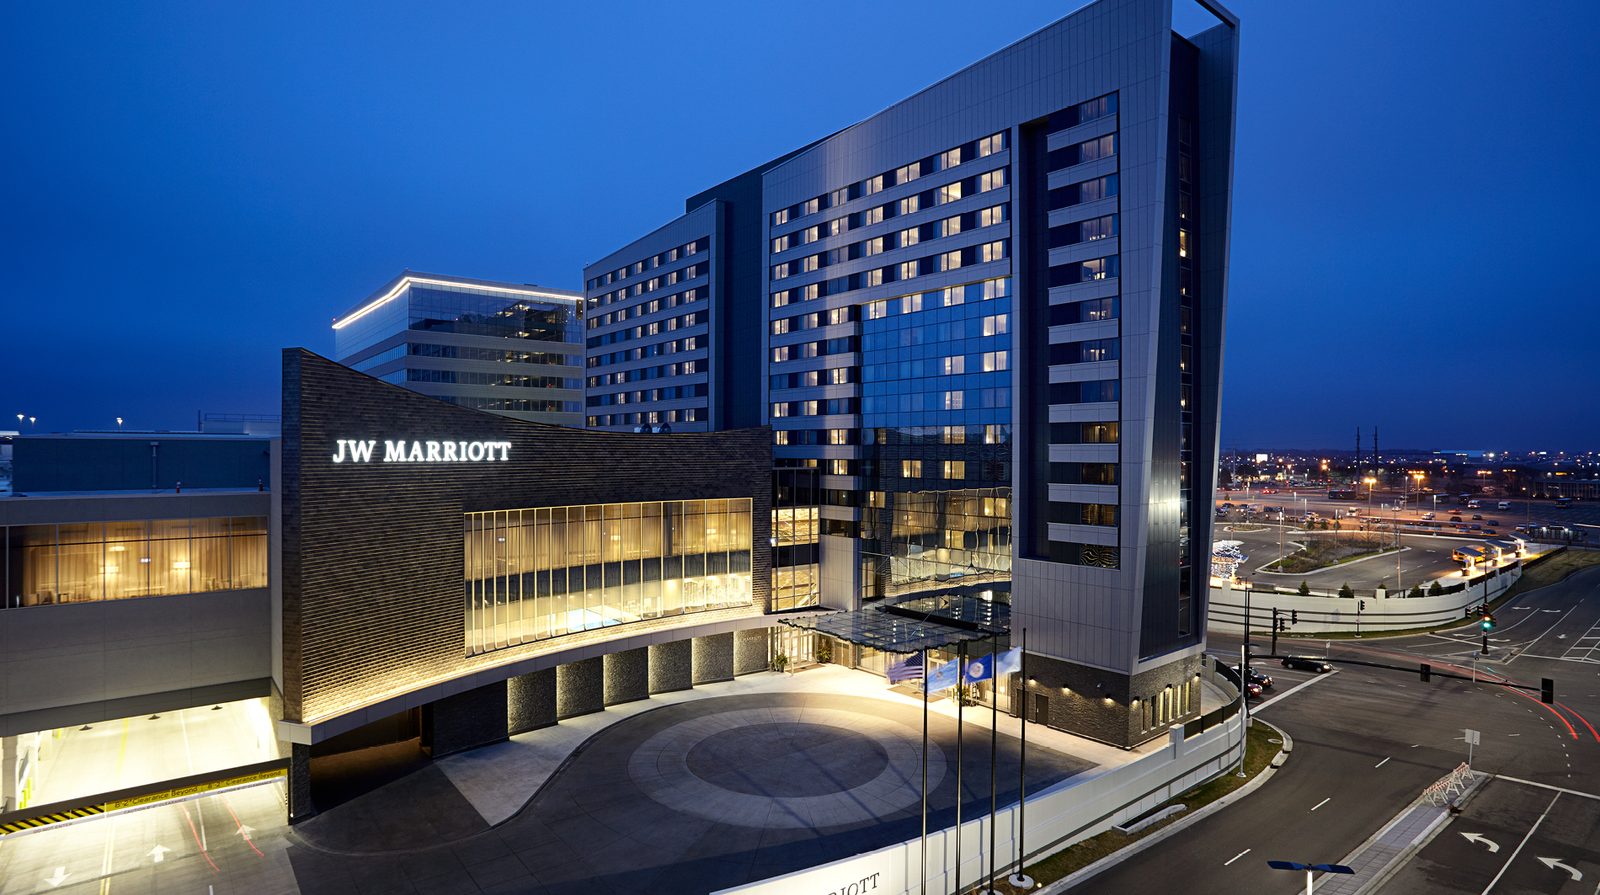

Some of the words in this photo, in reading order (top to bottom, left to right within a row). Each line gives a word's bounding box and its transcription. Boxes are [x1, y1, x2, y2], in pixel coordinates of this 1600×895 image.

[333, 439, 376, 463] JW
[383, 440, 511, 462] MARRIOTT
[133, 792, 169, 805] Clearance
[171, 786, 198, 797] Beyond
[828, 872, 880, 895] IOTT
